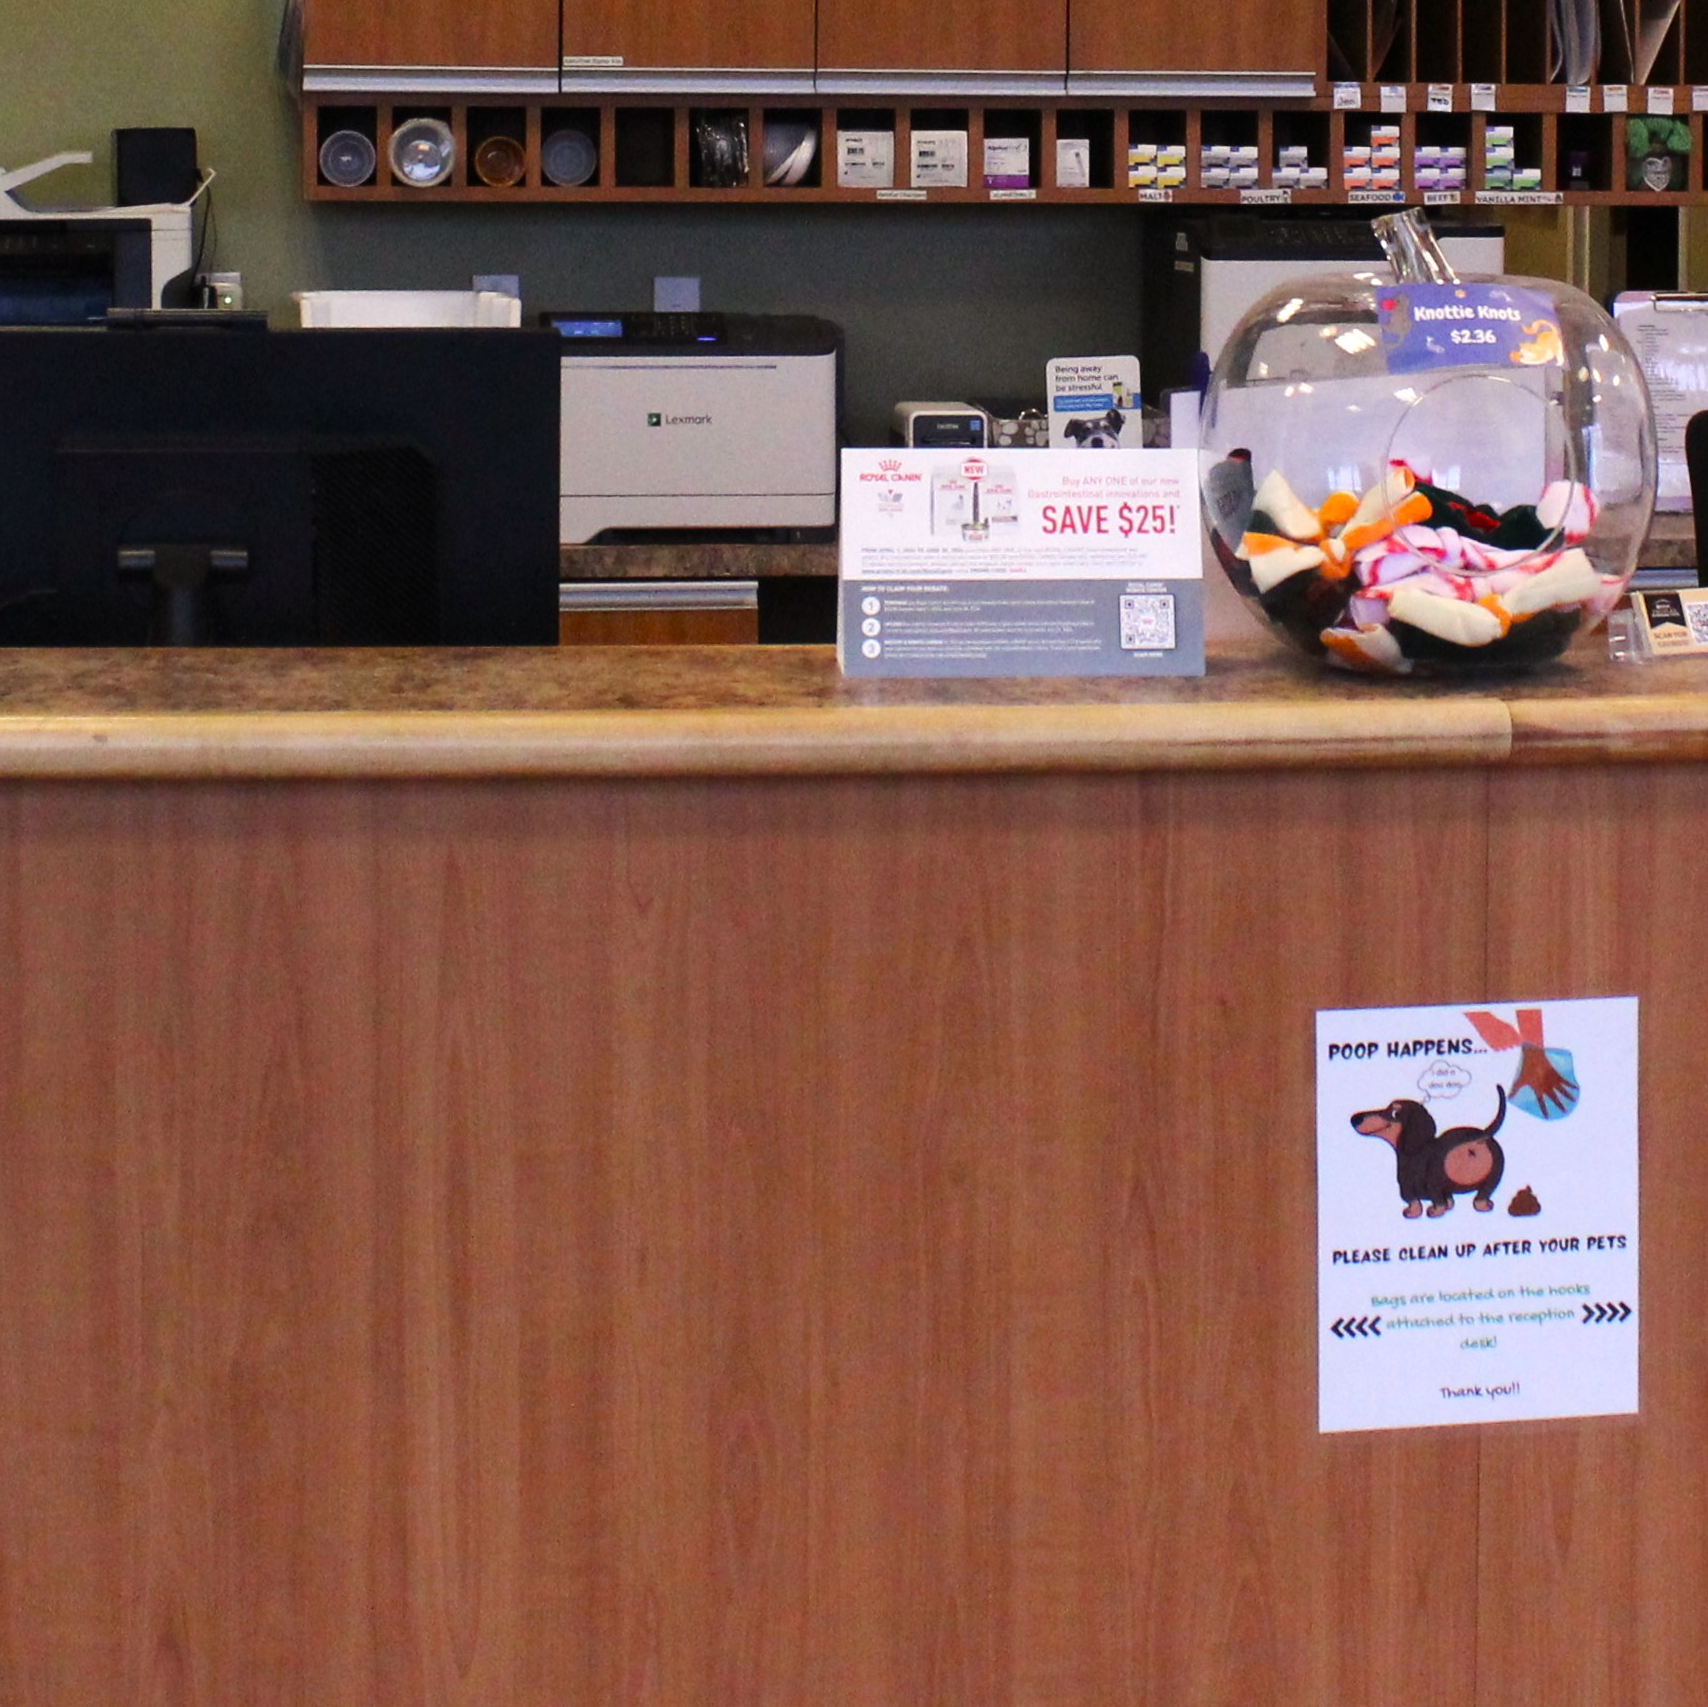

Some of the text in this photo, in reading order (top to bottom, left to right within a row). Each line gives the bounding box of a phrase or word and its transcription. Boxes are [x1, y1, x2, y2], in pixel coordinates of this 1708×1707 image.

[1139, 193, 1163, 201] MALT
[1242, 193, 1280, 203] POULTRY
[1349, 194, 1391, 202] SEAFOOD
[1413, 305, 1521, 322] Knottie Knots
[1450, 329, 1497, 344] $2.36
[1055, 366, 1079, 374] Being
[666, 414, 712, 425] Lexmark
[964, 465, 985, 474] NEW
[859, 473, 923, 482] ROYAL CANIN
[1062, 476, 1180, 488] Buy ANY ONE of our new
[1027, 489, 1180, 499] Gastrointestinal innovations and
[1042, 505, 1109, 534] SAVE
[1328, 1038, 1487, 1061] POOP HAPPENS...
[1333, 1235, 1627, 1265] PLEASE CLEAN UP AFTER YOUR PETS
[1371, 1283, 1591, 1309] Bags are located on the hooks
[1386, 1308, 1576, 1330] attached to the reception
[1460, 1336, 1497, 1350] desk!
[1440, 1381, 1521, 1400] Thank you!!
